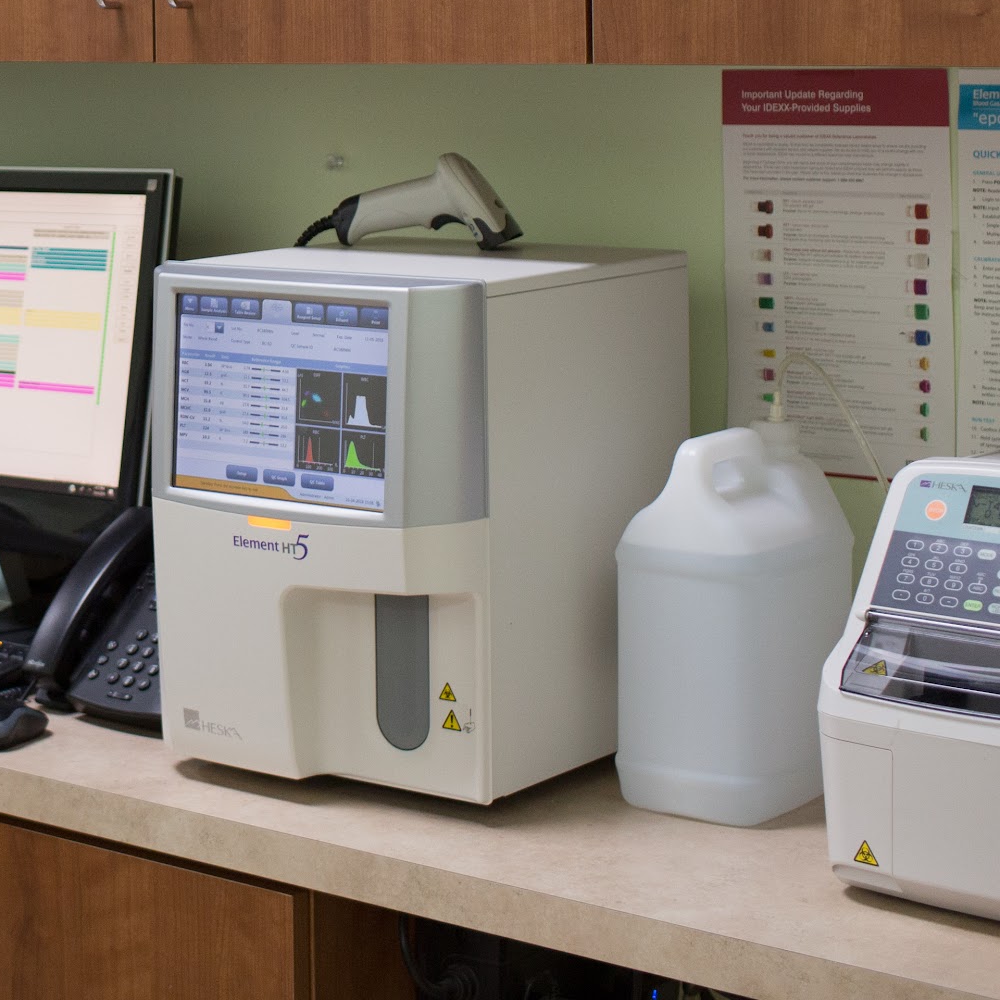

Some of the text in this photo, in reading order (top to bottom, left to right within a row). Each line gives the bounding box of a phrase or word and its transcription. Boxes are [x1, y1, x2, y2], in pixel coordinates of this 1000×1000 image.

[741, 90, 864, 101] Important Update Regarding
[741, 103, 872, 115] Your IDEXX-Provided Supplies
[932, 481, 967, 493] HESKA
[233, 534, 309, 560] Element HT5
[201, 720, 242, 741] HESKA
